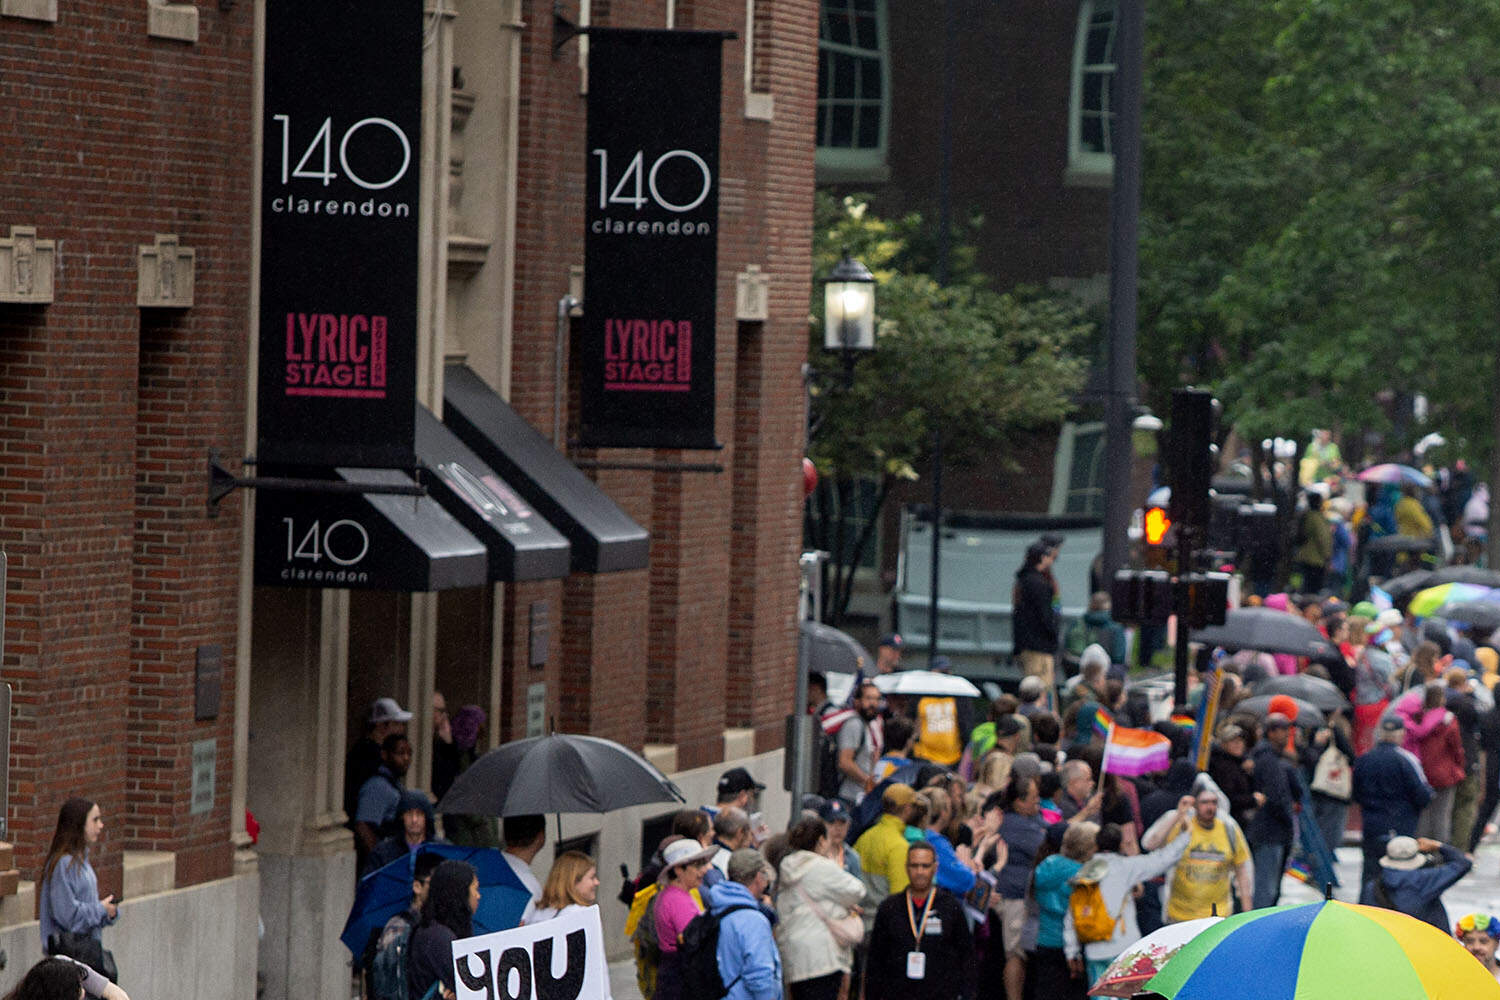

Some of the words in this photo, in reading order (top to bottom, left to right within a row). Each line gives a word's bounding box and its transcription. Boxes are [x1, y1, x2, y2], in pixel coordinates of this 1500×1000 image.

[273, 114, 411, 190] 140
[592, 149, 711, 212] 140
[272, 195, 410, 217] clarendon
[591, 217, 711, 235] clarendon
[286, 313, 369, 364] LYRIC
[605, 319, 675, 362] LYRIC
[285, 363, 368, 386] STAGE
[605, 361, 675, 381] STAGE
[283, 517, 369, 566] 140
[280, 567, 368, 583] clarendon
